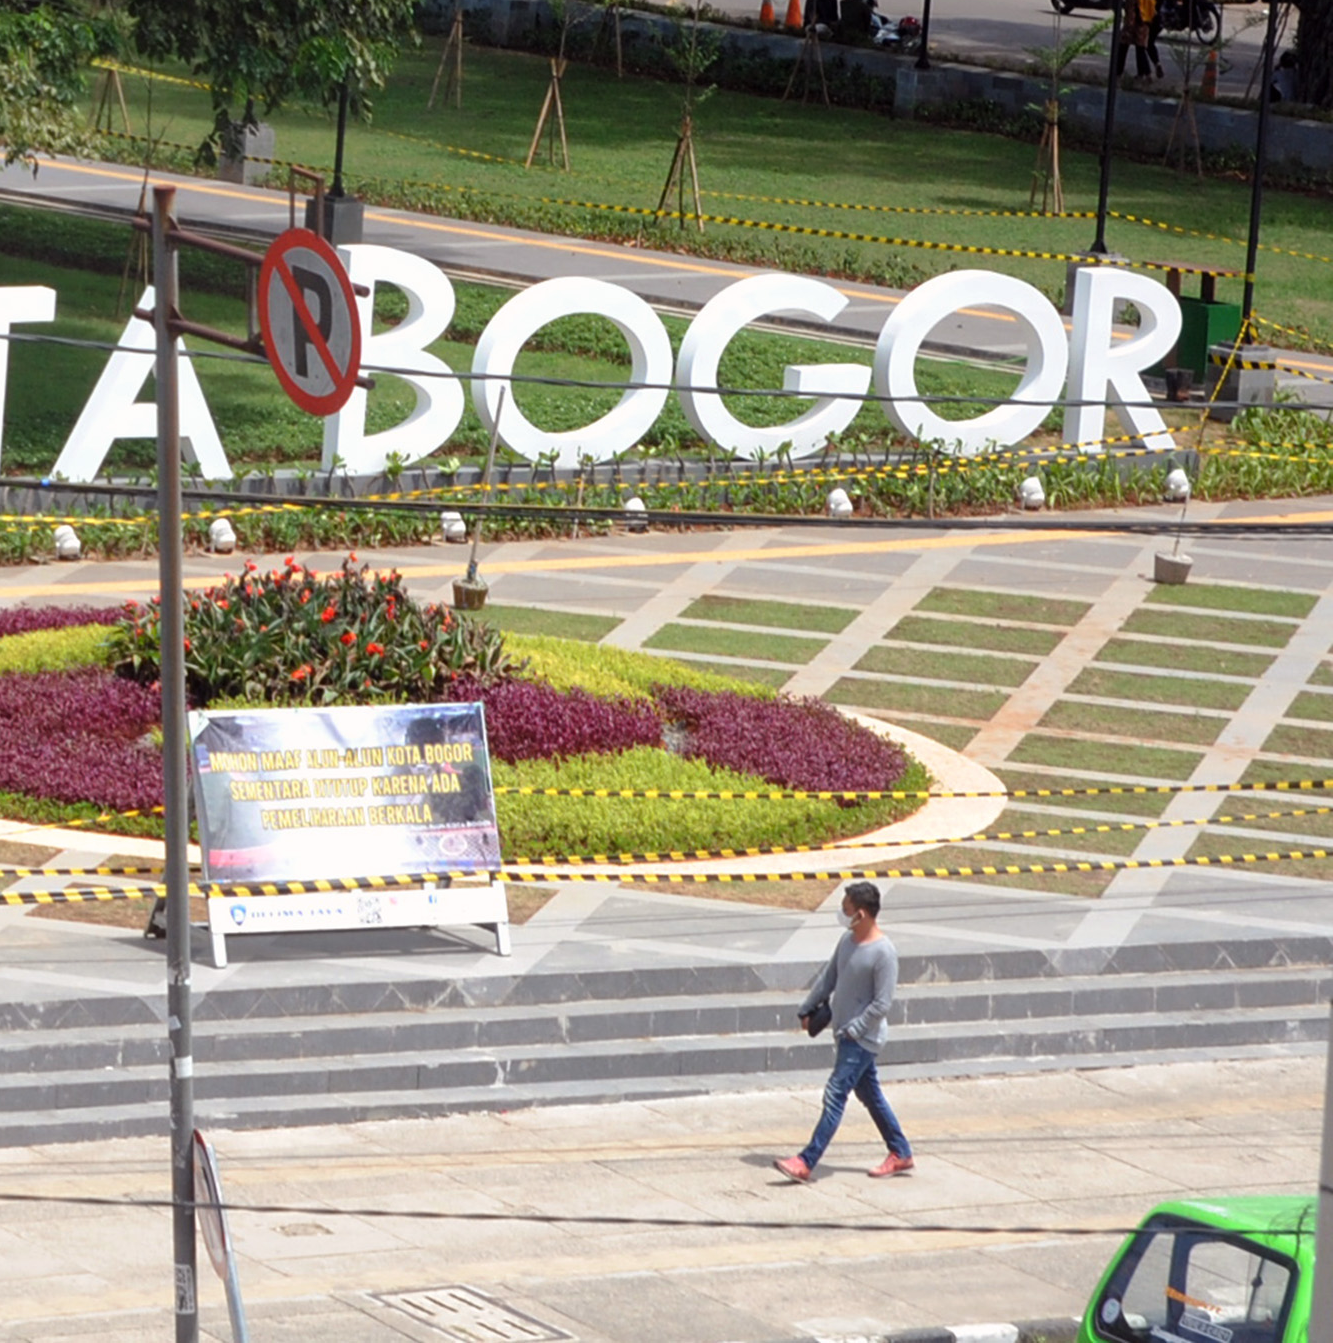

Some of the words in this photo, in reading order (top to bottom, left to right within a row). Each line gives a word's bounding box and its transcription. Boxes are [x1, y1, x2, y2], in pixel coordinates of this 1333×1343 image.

[291, 264, 332, 379] P
[322, 243, 1184, 474] BOGOR
[209, 750, 259, 773] MOHON
[260, 748, 301, 771] MAAF
[306, 747, 384, 769] ALUN-ALUN
[386, 744, 422, 767] KOTA
[423, 742, 473, 765] BOGOR
[229, 778, 311, 802] SEMENTARA
[313, 776, 368, 798] DITUTUP
[371, 774, 429, 796] KARENA
[431, 771, 462, 794] ADA
[260, 807, 366, 831] PEMELIHARAAN
[368, 803, 433, 825] BERKALA
